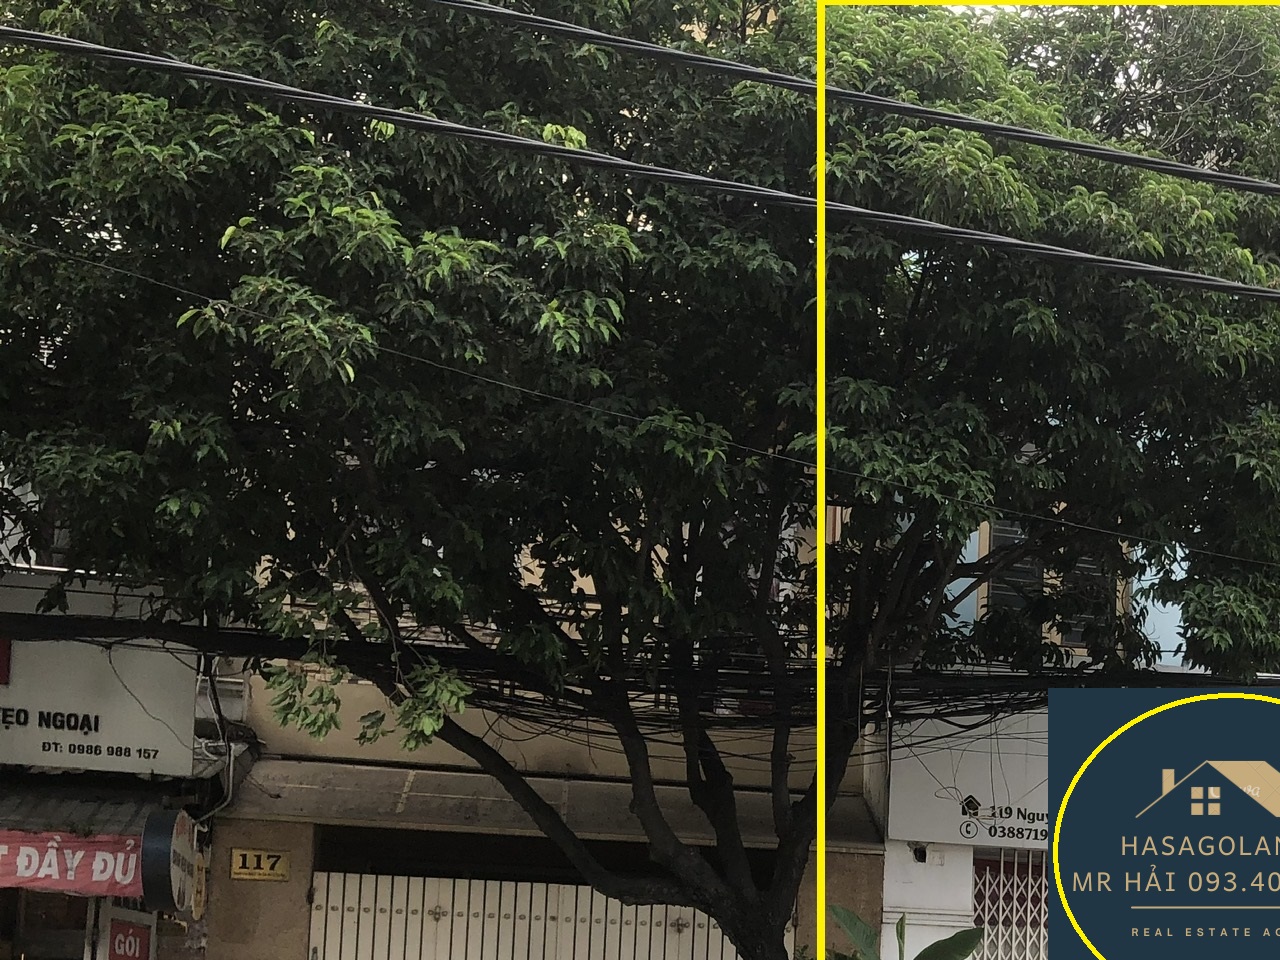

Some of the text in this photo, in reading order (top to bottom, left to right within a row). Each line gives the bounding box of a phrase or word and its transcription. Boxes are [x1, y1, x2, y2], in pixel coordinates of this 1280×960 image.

[0, 707, 99, 735] ẸO NGOẠI
[42, 742, 159, 759] ĐT: 0986 988 157
[989, 826, 1048, 841] 0388719
[16, 835, 85, 880] ĐẦY
[92, 839, 137, 885] ĐỦ
[238, 853, 282, 871] 117
[114, 928, 140, 958] GÓI
